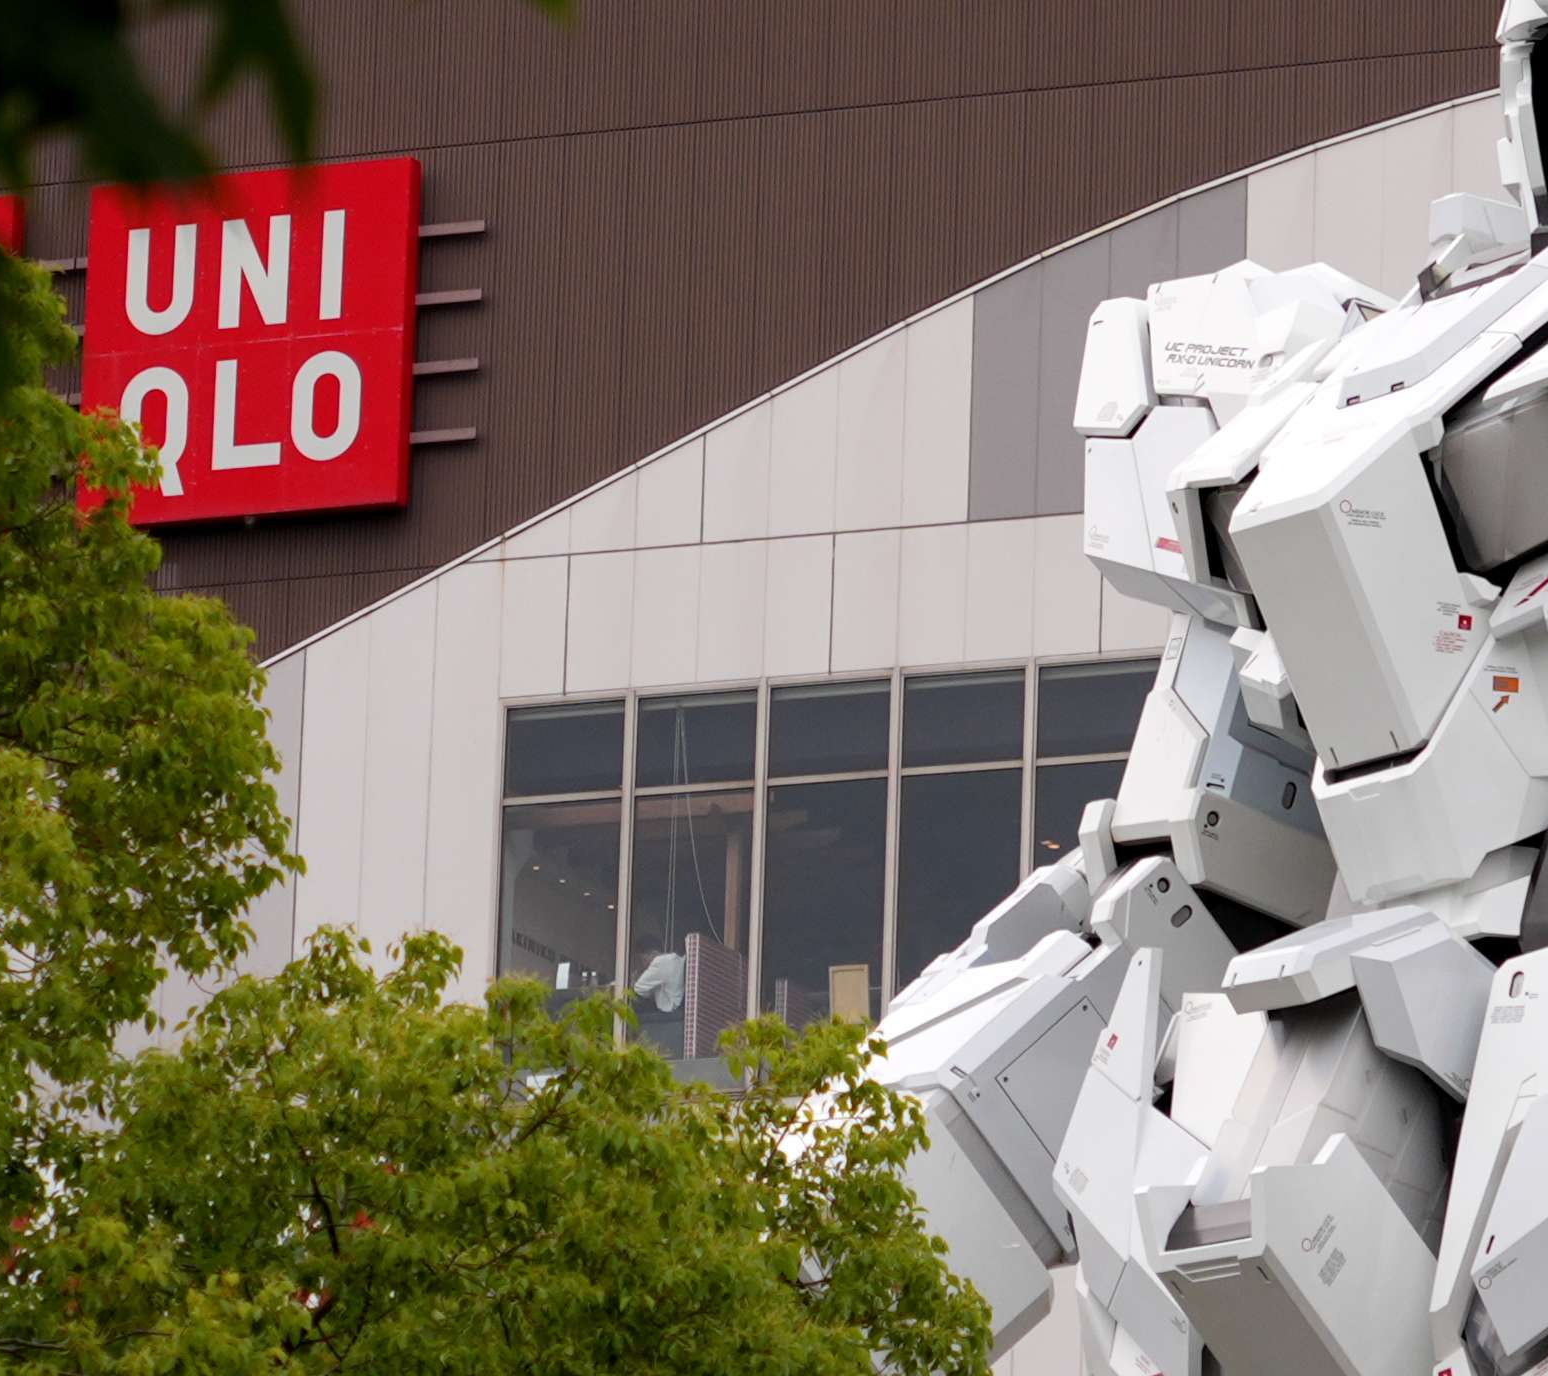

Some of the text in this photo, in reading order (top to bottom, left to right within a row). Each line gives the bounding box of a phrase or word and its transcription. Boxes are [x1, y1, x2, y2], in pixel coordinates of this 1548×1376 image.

[124, 208, 346, 336] UNI
[1185, 343, 1250, 357] PROJECT
[1196, 356, 1255, 369] UNICORN
[119, 350, 362, 497] QLO
